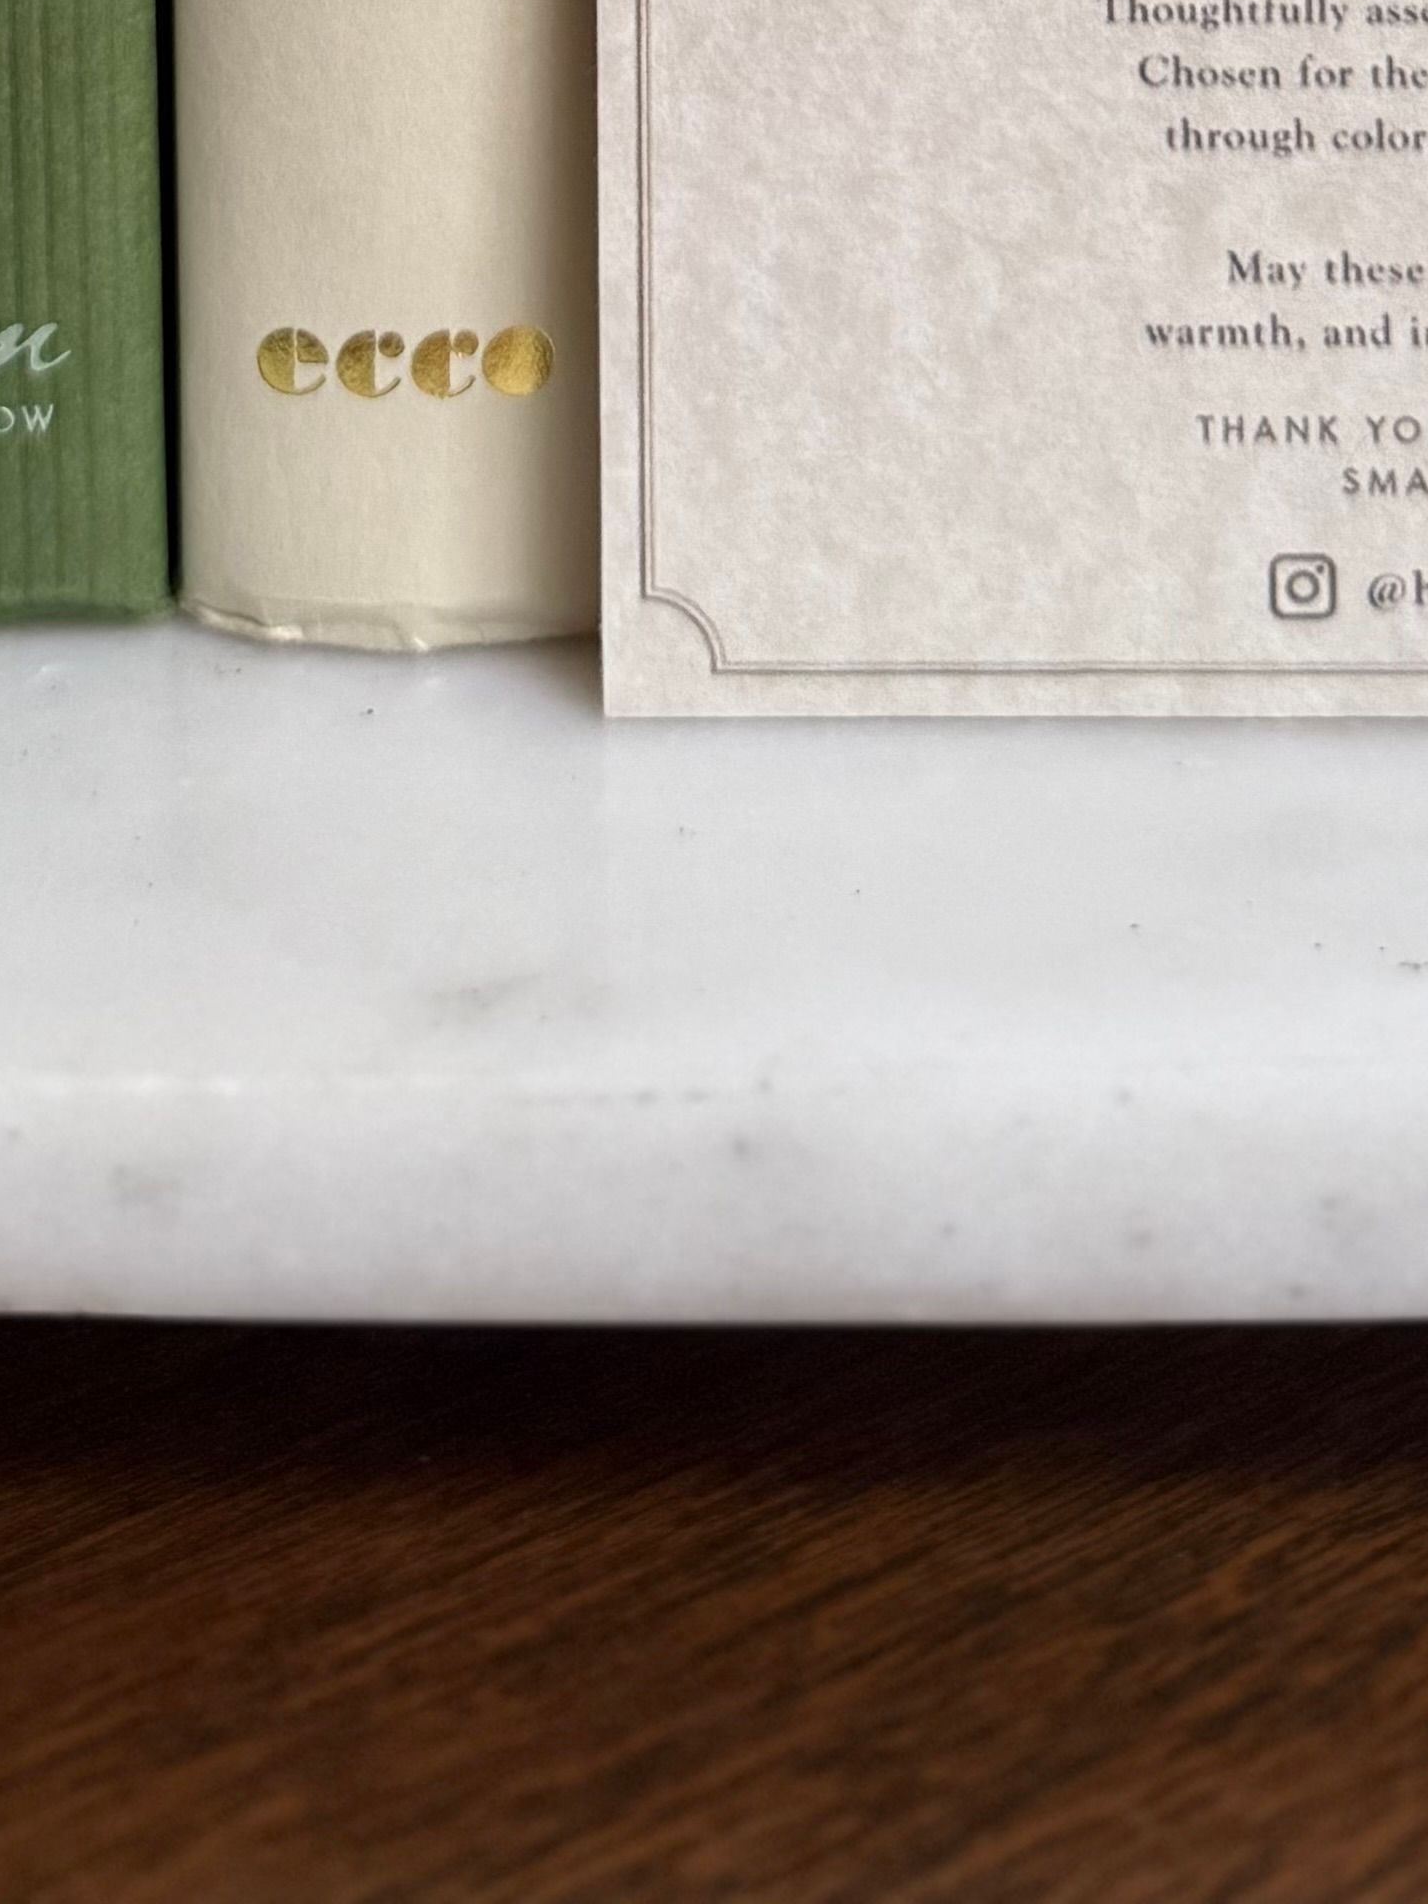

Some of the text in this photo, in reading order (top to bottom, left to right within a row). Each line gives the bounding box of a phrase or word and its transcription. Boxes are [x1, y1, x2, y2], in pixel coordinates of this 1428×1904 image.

[1137, 52, 1283, 92] Chosen
[1297, 52, 1356, 92] for
[1165, 115, 1318, 163] through
[1226, 248, 1307, 297] May
[1323, 248, 1425, 290] these
[1143, 311, 1308, 357] warmth,
[1322, 310, 1393, 352] and
[257, 327, 555, 399] ecco
[1195, 413, 1340, 448] THANK
